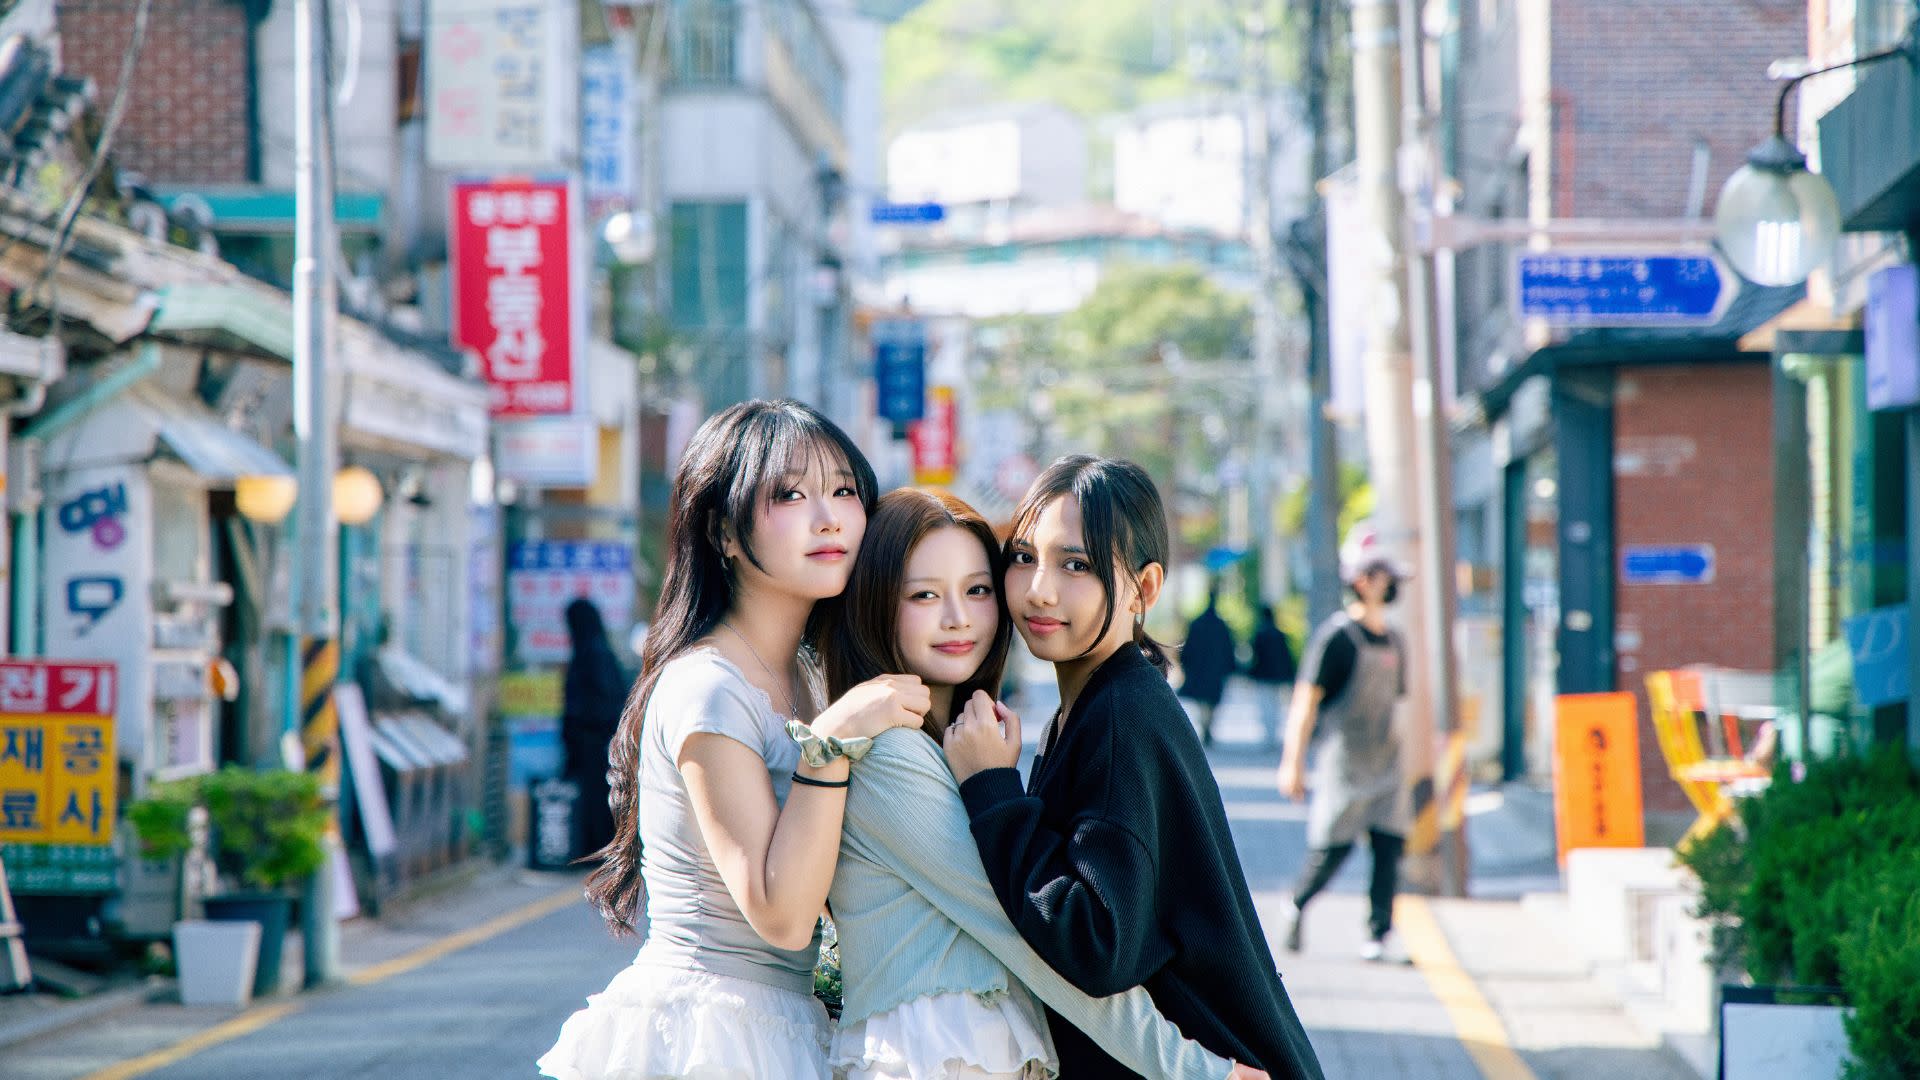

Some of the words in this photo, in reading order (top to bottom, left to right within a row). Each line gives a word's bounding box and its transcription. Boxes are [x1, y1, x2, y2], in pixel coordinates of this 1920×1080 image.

[485, 227, 546, 380] 부동산
[1, 667, 113, 712] 전기
[1, 726, 44, 831] 재료
[59, 726, 103, 834] 공사
